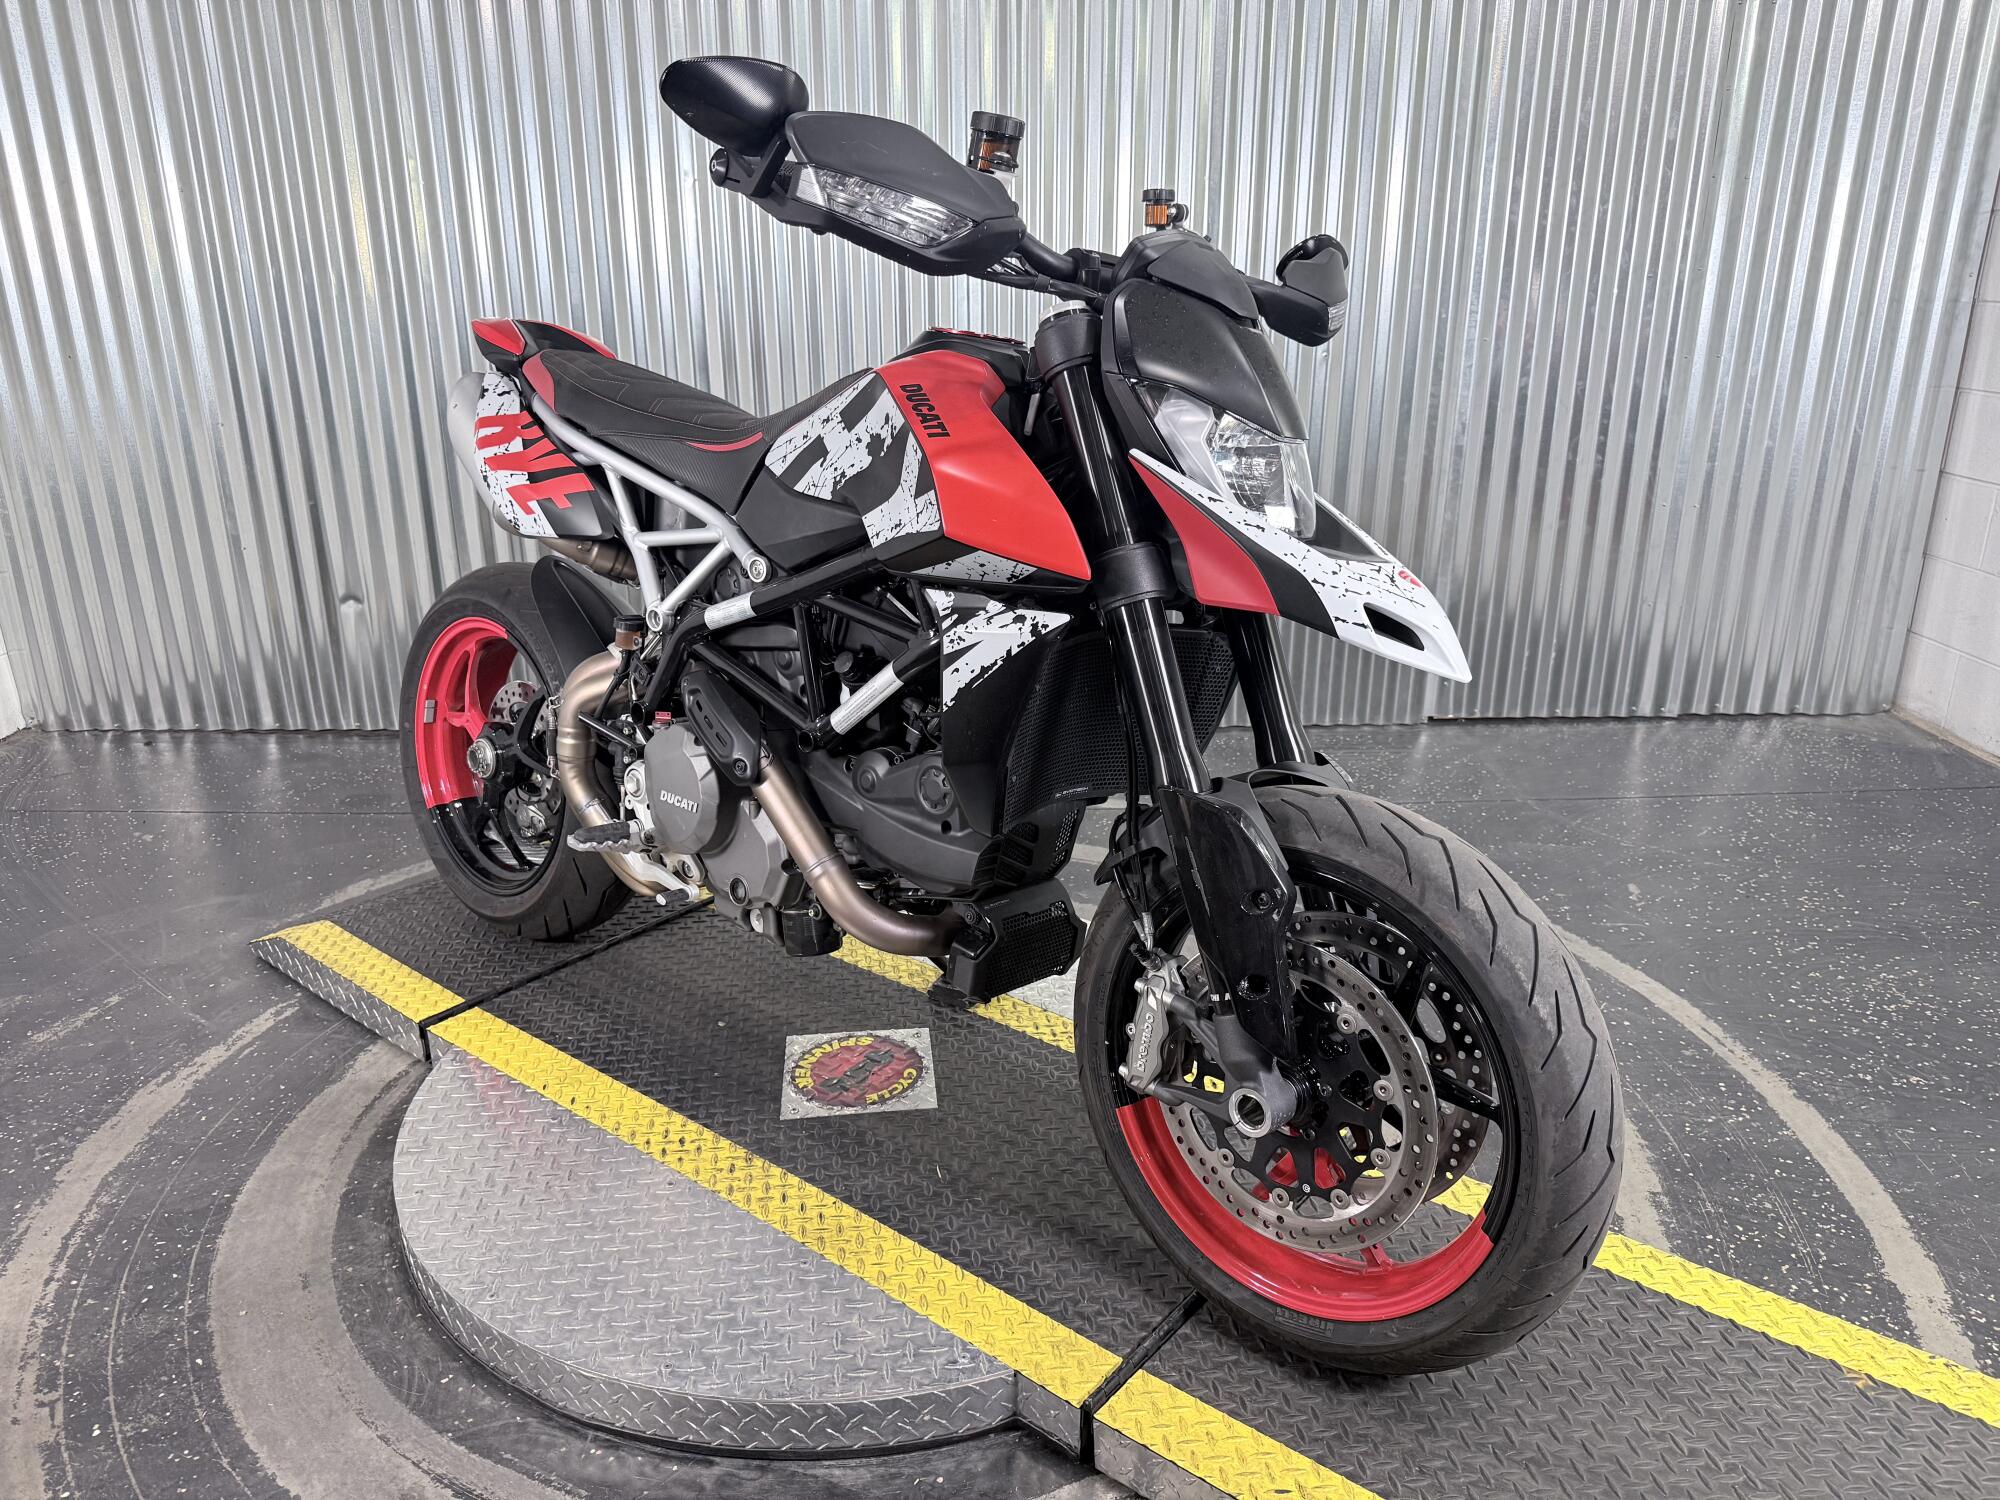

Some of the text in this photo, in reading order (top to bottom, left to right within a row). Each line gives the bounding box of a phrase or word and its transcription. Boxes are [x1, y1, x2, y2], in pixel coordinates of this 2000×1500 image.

[900, 383, 951, 438] DUCATI
[660, 789, 699, 814] DUCATI
[793, 1036, 875, 1089] SPINNER
[1134, 1012, 1155, 1072] brembo
[865, 1067, 918, 1104] CYCLE
